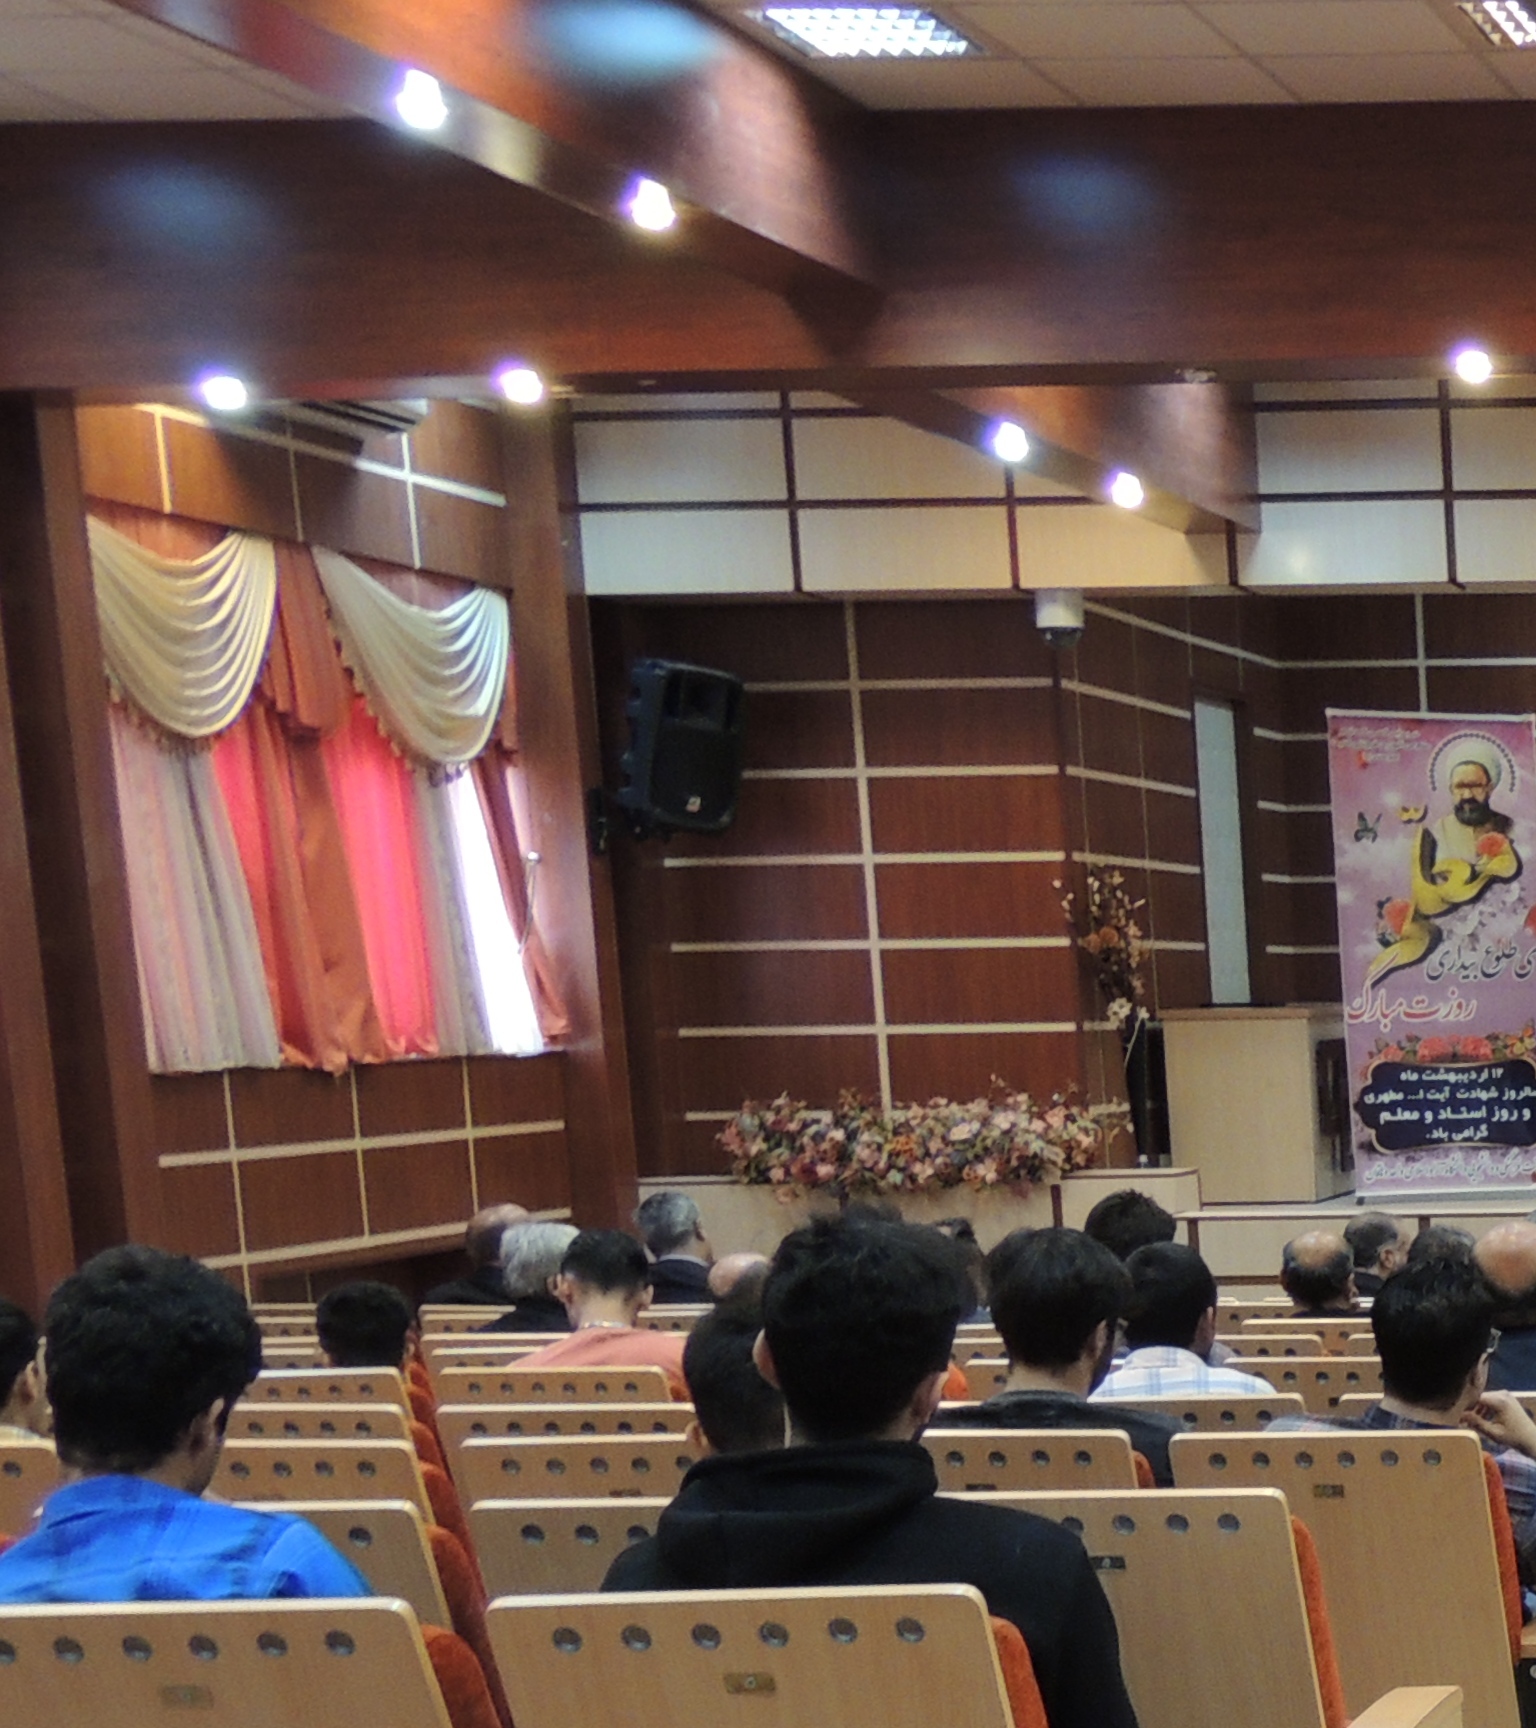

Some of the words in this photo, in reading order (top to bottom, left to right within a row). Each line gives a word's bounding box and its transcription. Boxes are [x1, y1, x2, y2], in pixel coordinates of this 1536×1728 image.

[1426, 945, 1479, 981] بیداری
[1480, 941, 1518, 979] طلوع
[1346, 952, 1404, 1032] مبارک
[1402, 988, 1478, 1022] روزت
[1399, 1069, 1419, 1082] ماه
[1421, 1067, 1490, 1083] اردیبهشت
[1363, 1089, 1405, 1105] مطهری
[1455, 1085, 1500, 1101] شهادت
[1379, 1106, 1421, 1125] معلم
[1437, 1105, 1488, 1120] استاد
[1490, 1105, 1519, 1122] روز
[1451, 1123, 1489, 1142] گرامی
